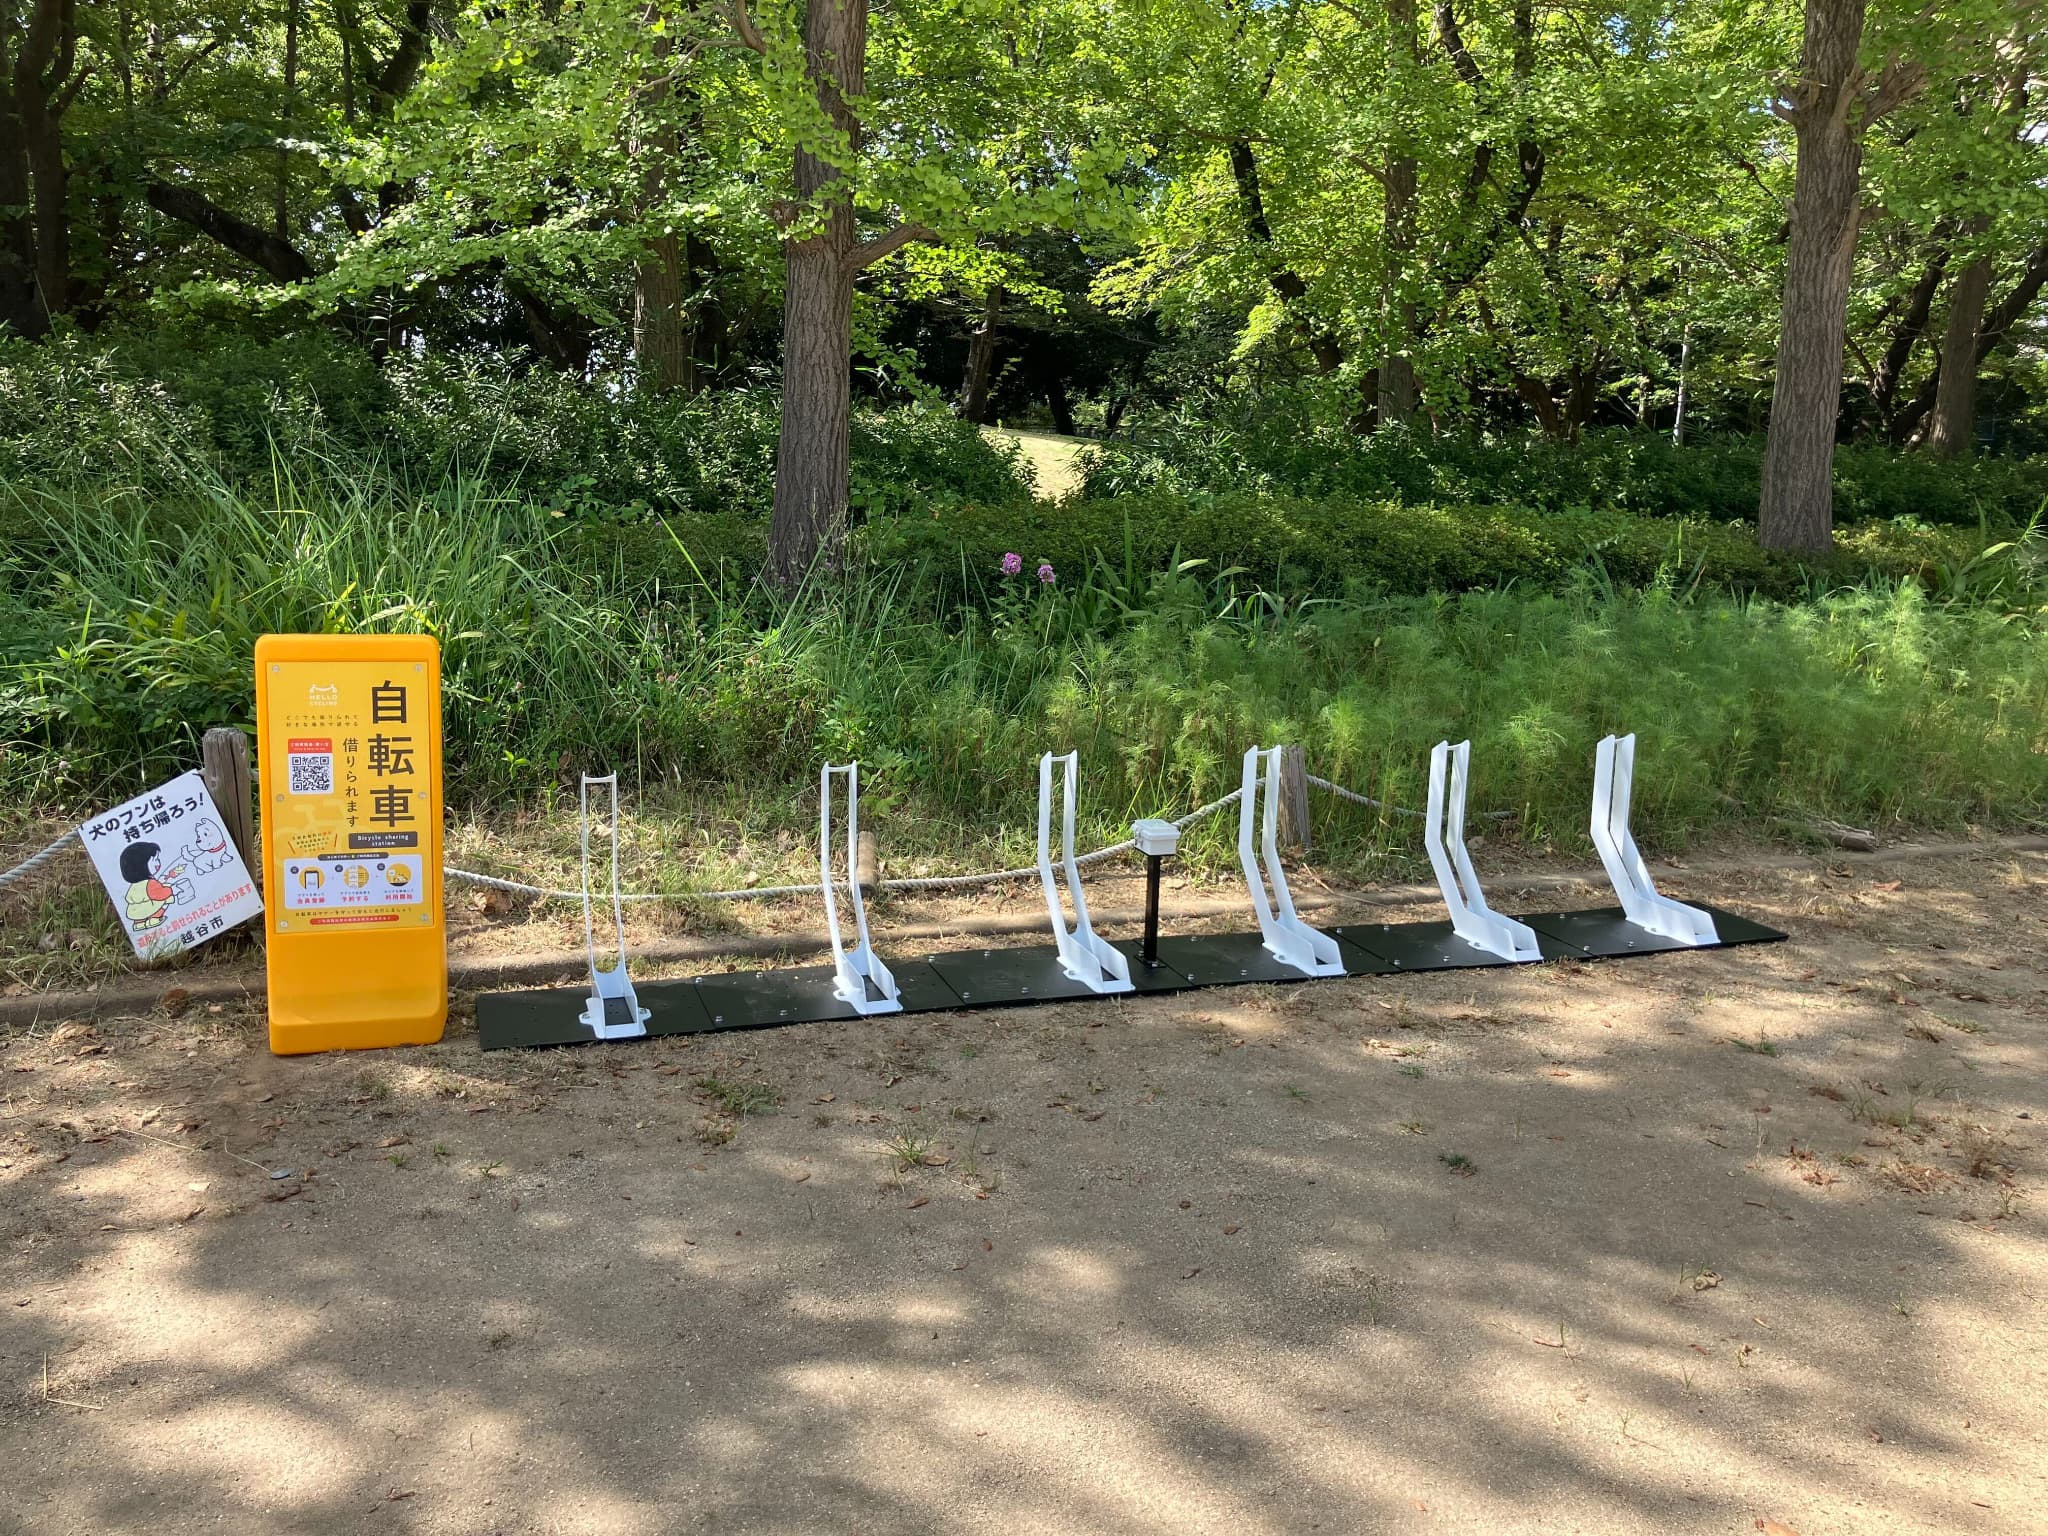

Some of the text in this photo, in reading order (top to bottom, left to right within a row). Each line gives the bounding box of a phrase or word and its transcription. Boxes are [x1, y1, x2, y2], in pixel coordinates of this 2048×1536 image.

[343, 737, 359, 827] 借りられます
[367, 680, 415, 827] 自転車
[88, 795, 166, 842] 犬のフンは
[180, 916, 224, 944] 越谷市
